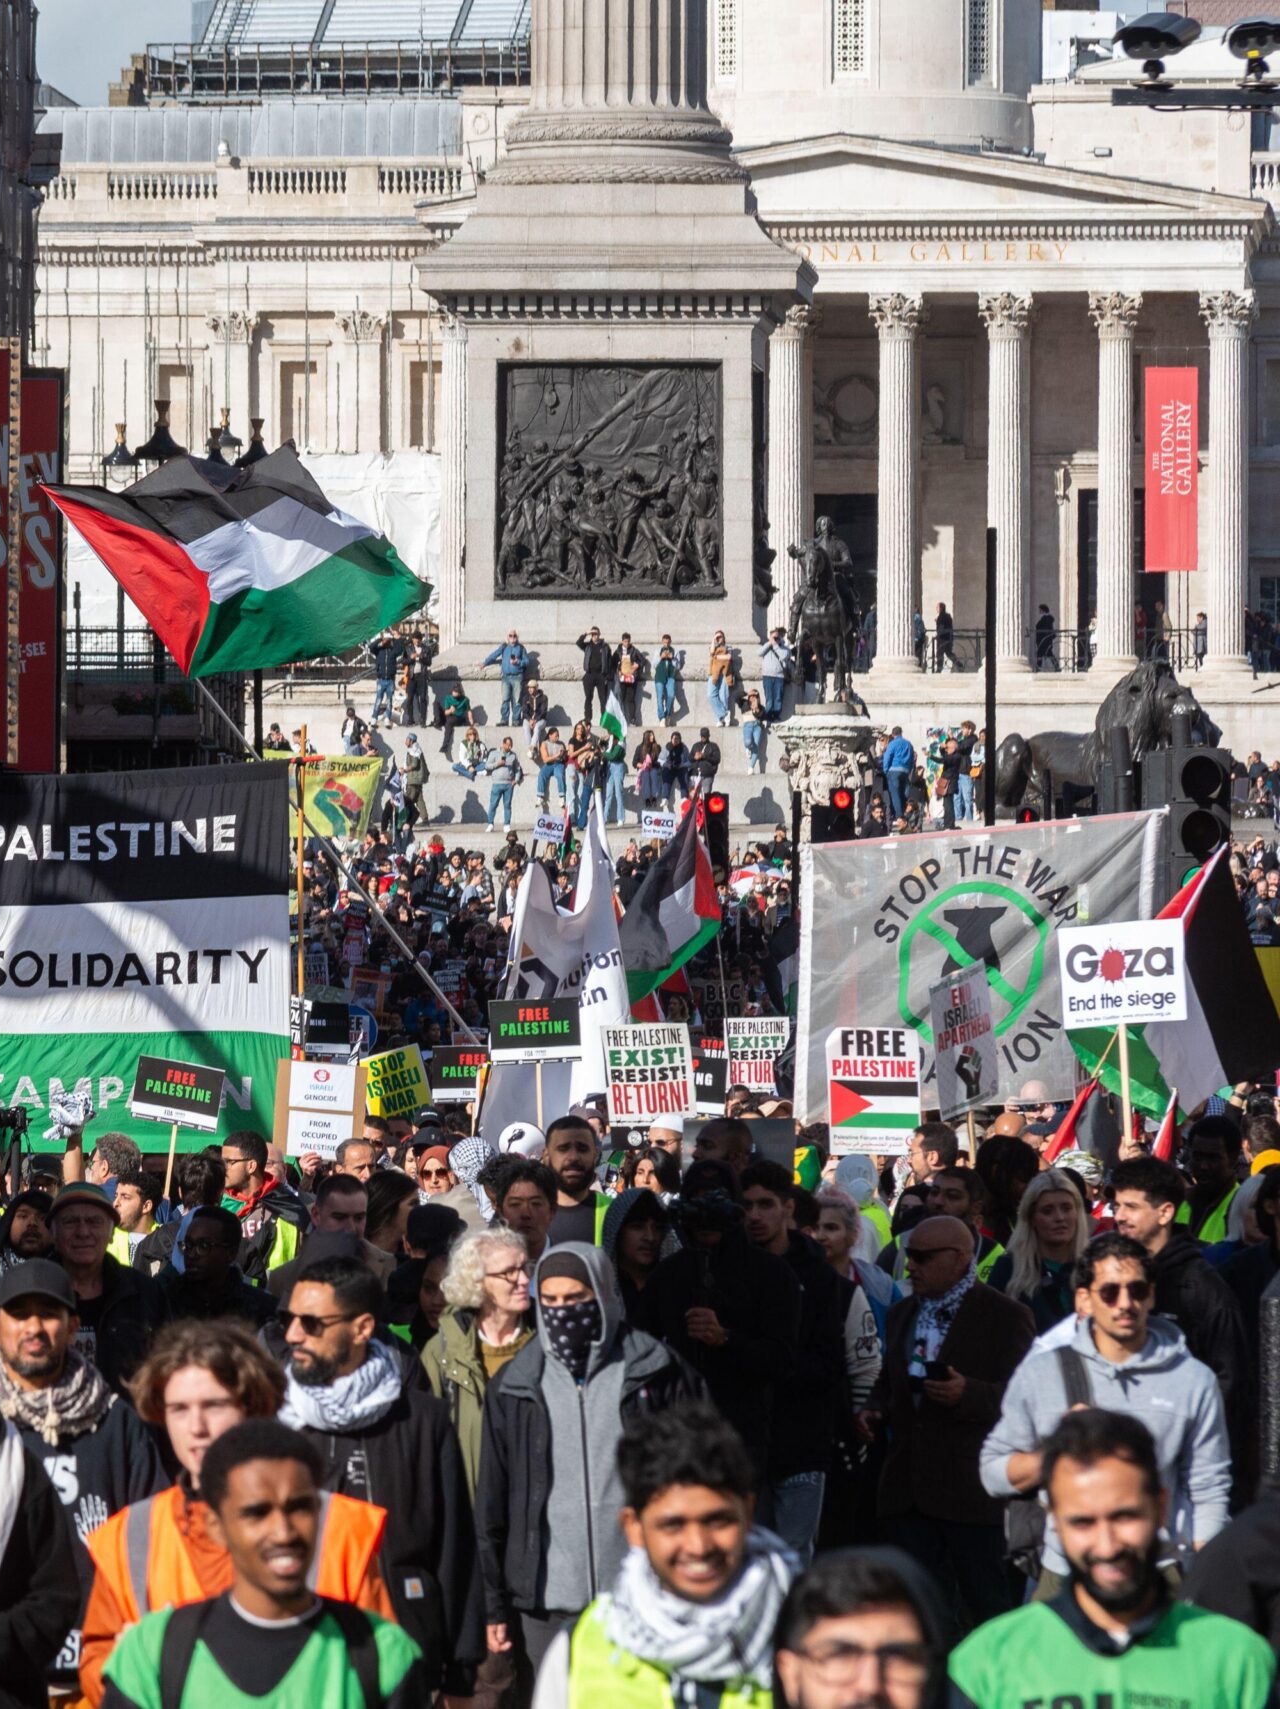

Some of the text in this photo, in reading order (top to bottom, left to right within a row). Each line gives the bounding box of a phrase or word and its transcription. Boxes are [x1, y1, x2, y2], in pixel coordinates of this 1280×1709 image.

[794, 243, 1068, 262] ONAL GALLERY
[1161, 400, 1174, 495] NATIONAL
[1176, 400, 1191, 495] GALLERY
[537, 818, 564, 832] Gza
[644, 815, 674, 827] Gza
[873, 845, 1079, 944] STOP THE WAR
[1066, 943, 1175, 983] Gza
[1069, 990, 1176, 1012] End the siege
[518, 1007, 549, 1022] FREE
[944, 998, 981, 1030] ISRAELI
[500, 1020, 570, 1036] PALESTINE
[728, 1022, 745, 1034] FREE
[748, 1021, 785, 1034] PALESTINE
[937, 1013, 991, 1054] APARTHEID
[606, 1028, 683, 1047] FREE PALESTINE
[729, 1036, 785, 1049] EXIST!
[841, 1030, 906, 1057] FREE
[369, 1051, 406, 1078] STOP
[459, 1054, 486, 1066] FREE
[609, 1047, 685, 1067] EXIST!
[730, 1050, 781, 1061] RESIST
[166, 1069, 196, 1086] FREE
[442, 1065, 477, 1078] PALES
[610, 1065, 686, 1082] RESIST!
[730, 1060, 775, 1084] RETUR
[832, 1059, 916, 1078] PALESTINE
[145, 1079, 212, 1103] PALESTINE
[367, 1066, 421, 1098] ISRAELI
[304, 1094, 337, 1102] GENOCIDE
[381, 1088, 417, 1114] WAR
[612, 1080, 689, 1115] RETURN!
[309, 1120, 331, 1128] FROM
[301, 1131, 337, 1140] OCCUPIED
[300, 1143, 336, 1151] PALESTINE
